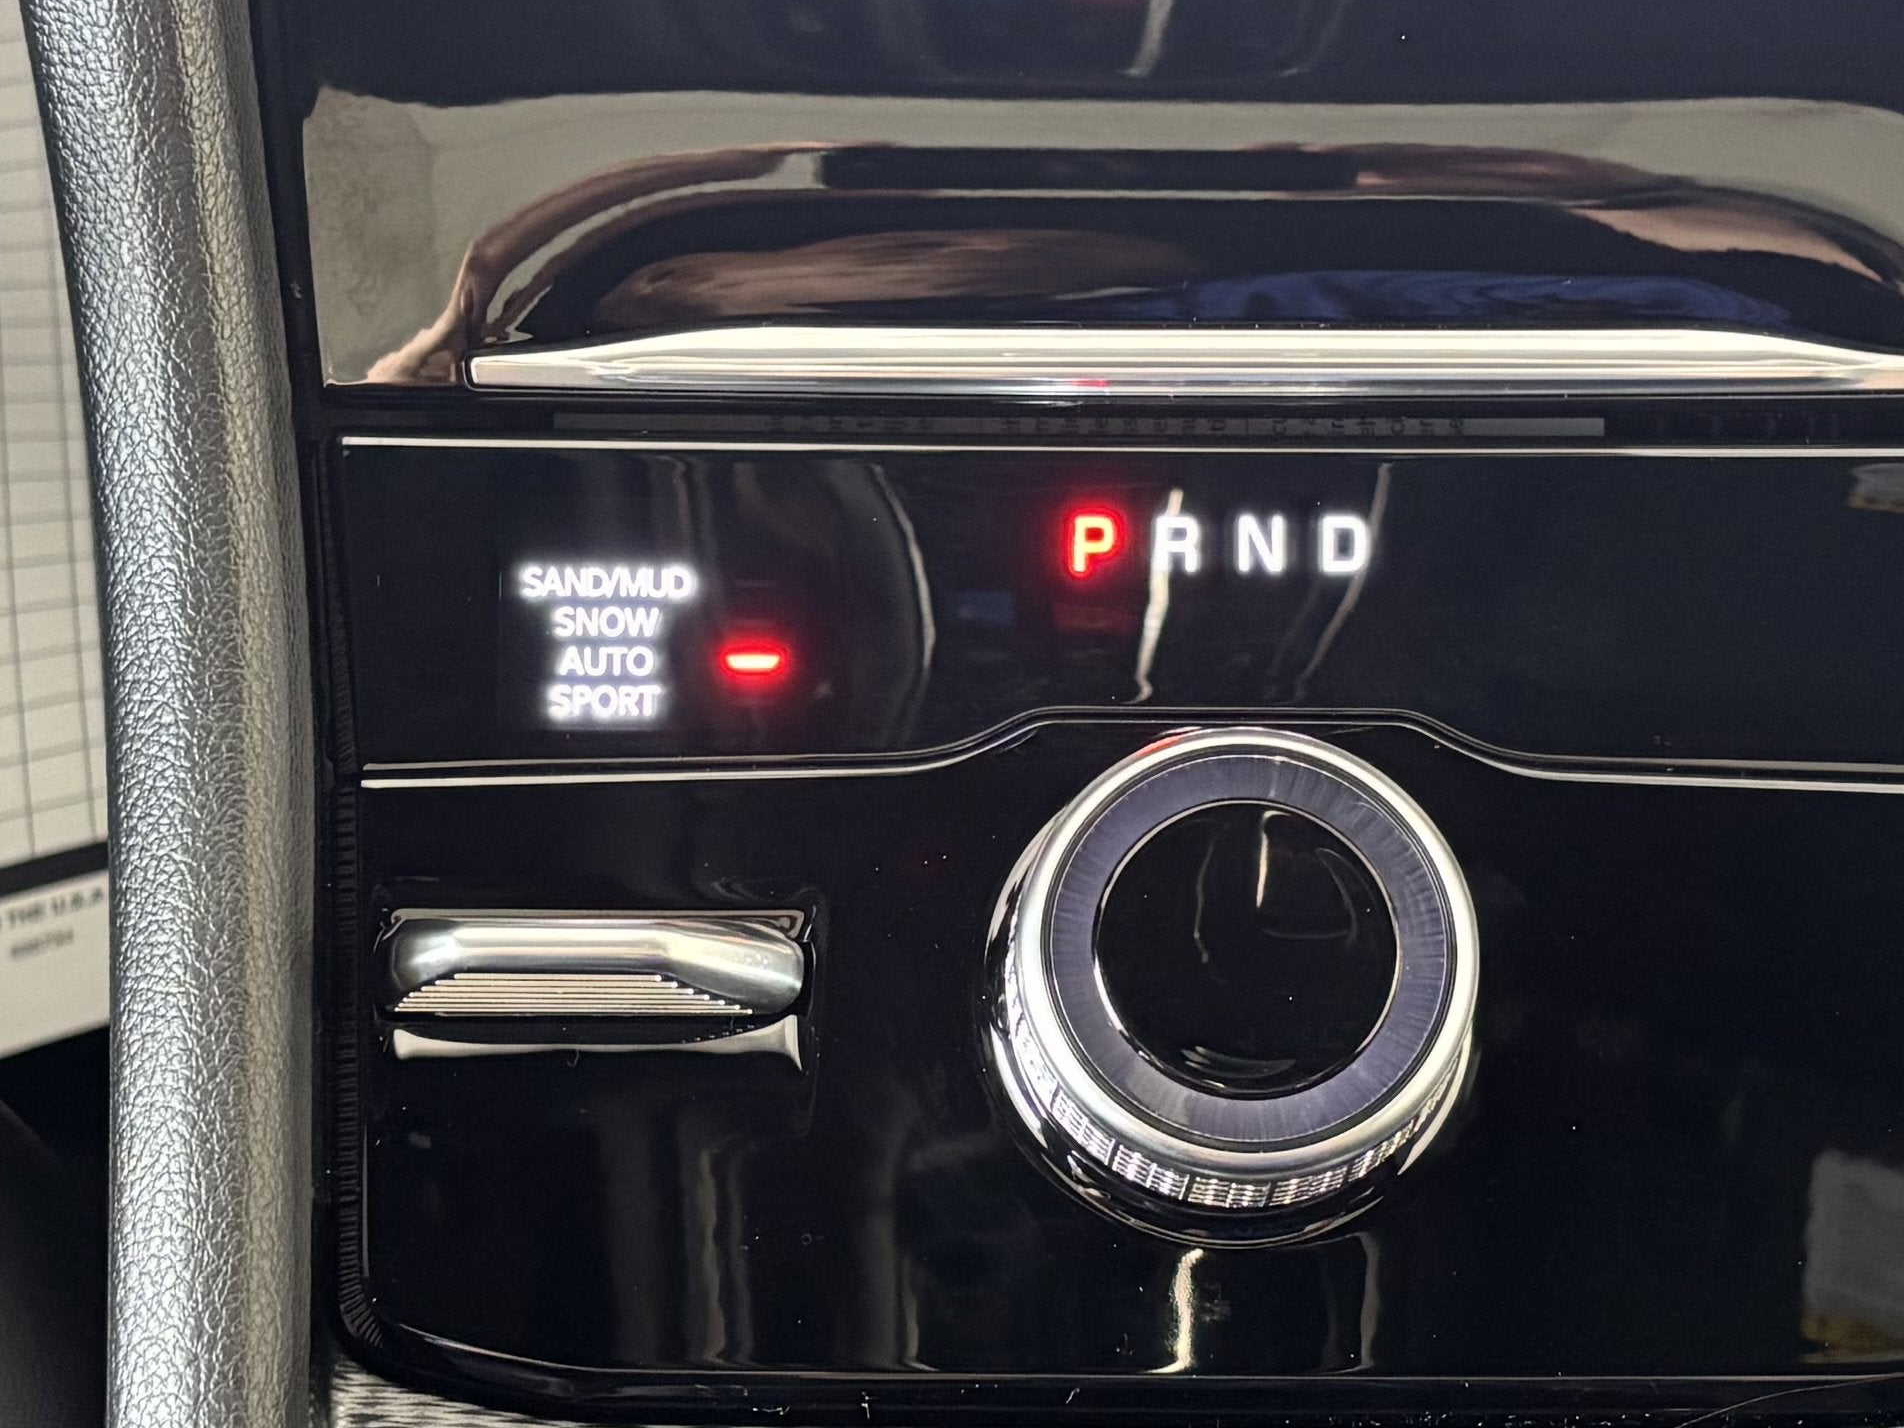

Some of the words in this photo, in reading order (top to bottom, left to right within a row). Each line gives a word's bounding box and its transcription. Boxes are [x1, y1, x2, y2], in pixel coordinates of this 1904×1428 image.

[1070, 512, 1119, 576] P
[1152, 512, 1202, 575] R
[1236, 513, 1286, 575] N
[1317, 513, 1372, 575] D
[519, 566, 695, 600] SAND/MUD
[552, 606, 661, 638] SNOW
[557, 645, 655, 677] AUTO
[546, 684, 662, 718] SPORT
